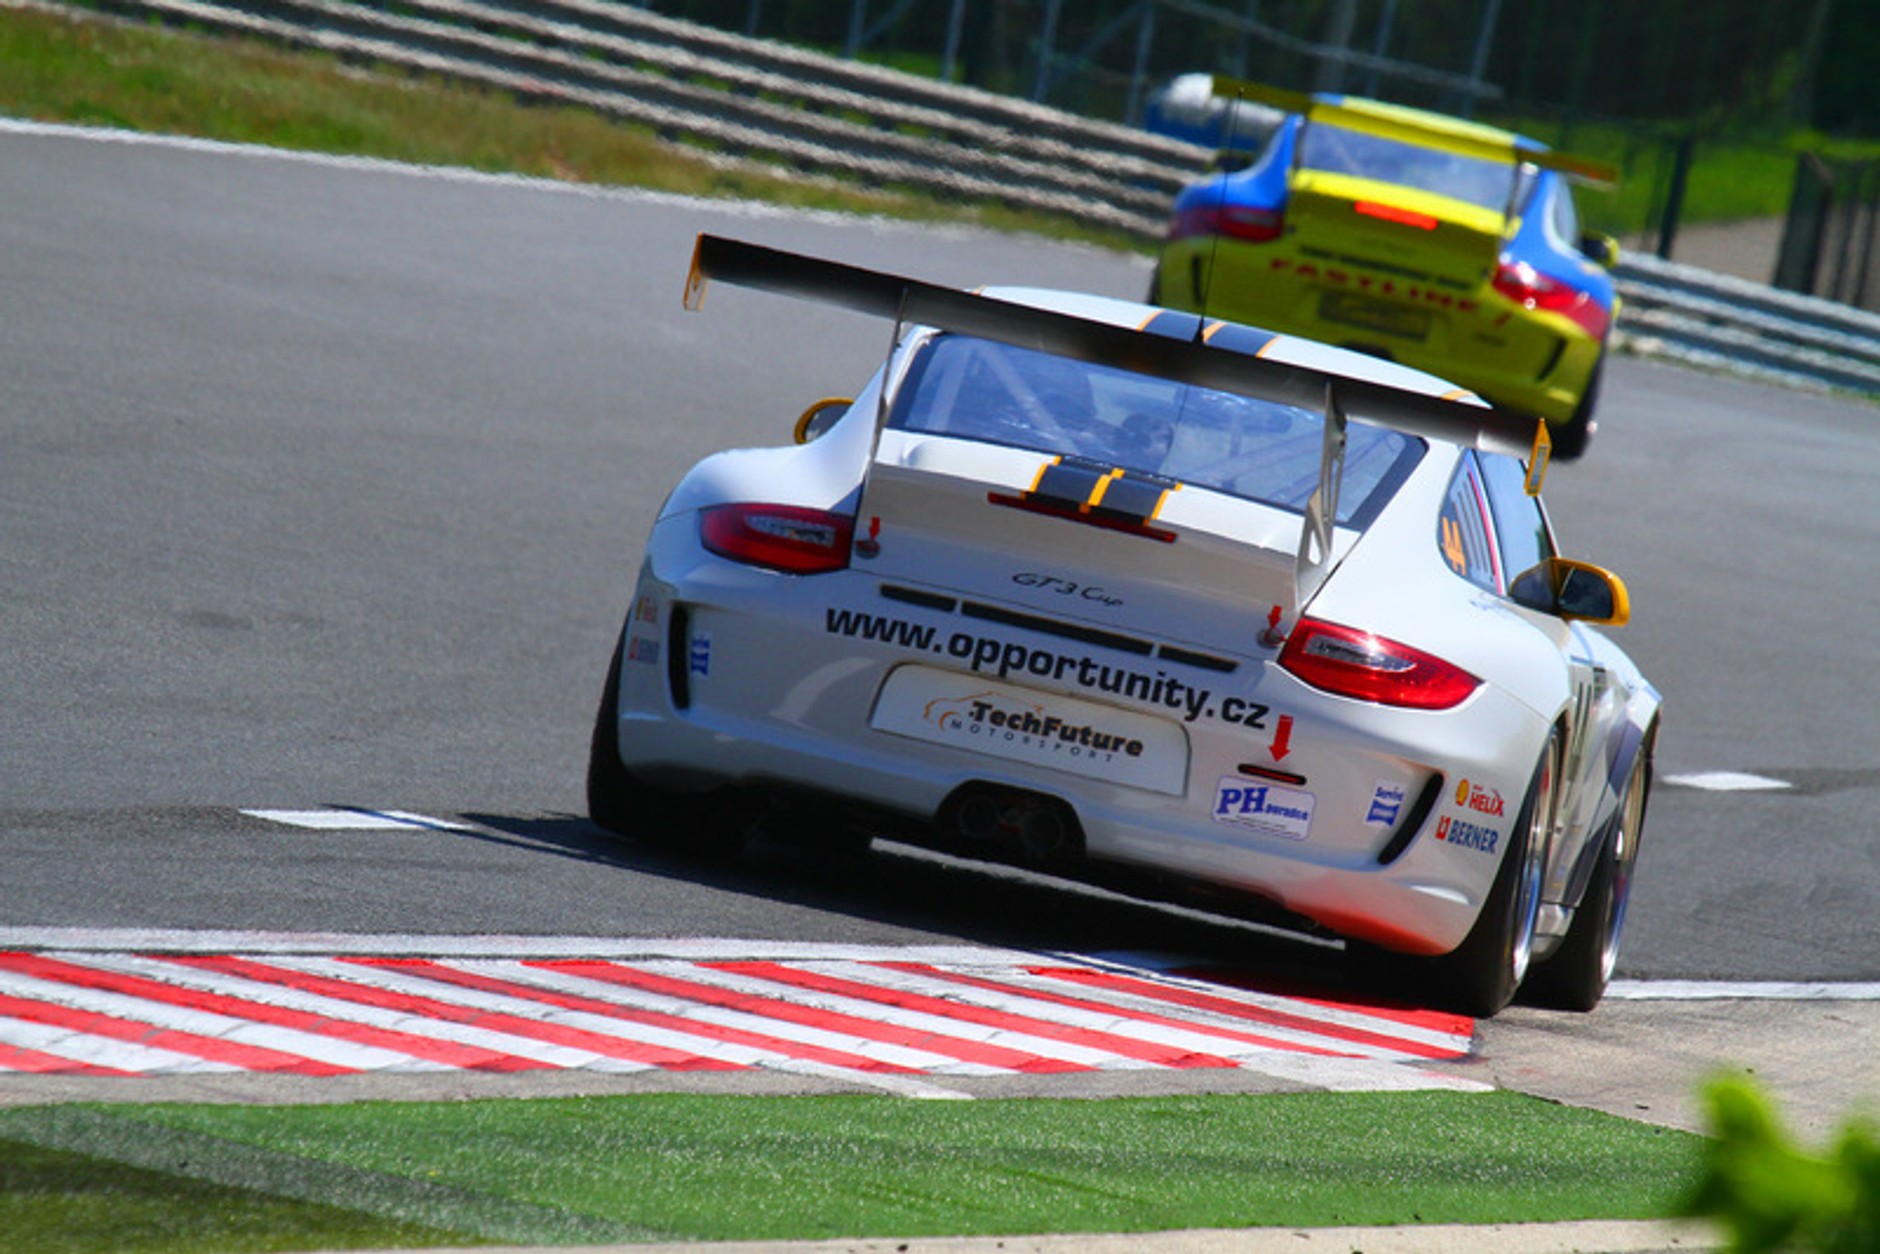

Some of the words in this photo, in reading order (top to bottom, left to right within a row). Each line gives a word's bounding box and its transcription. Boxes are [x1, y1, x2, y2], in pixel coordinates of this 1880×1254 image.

[826, 607, 1270, 731] www.opportunity.cz
[951, 718, 1113, 763] MOTORSPORT
[1216, 786, 1270, 815] PH
[1469, 791, 1505, 818] HELIX
[1447, 819, 1499, 855] BERNER
